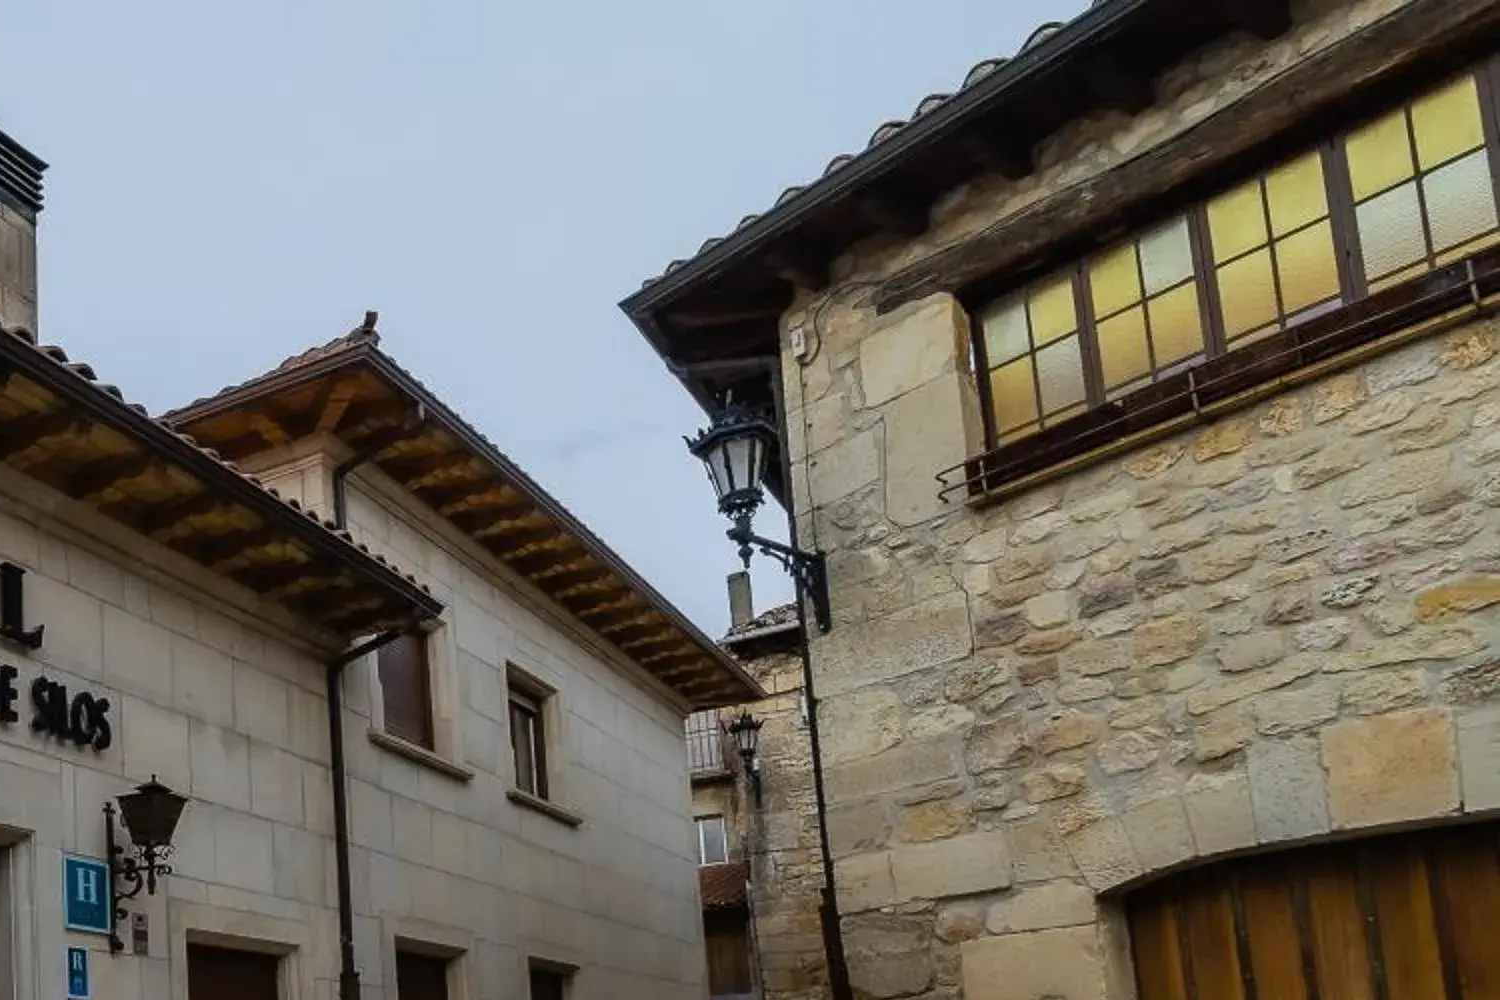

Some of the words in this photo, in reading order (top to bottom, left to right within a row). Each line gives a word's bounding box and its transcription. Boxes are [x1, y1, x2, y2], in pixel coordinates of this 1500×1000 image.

[31, 676, 112, 752] SILOS
[75, 867, 99, 905] H
[72, 951, 83, 971] R
